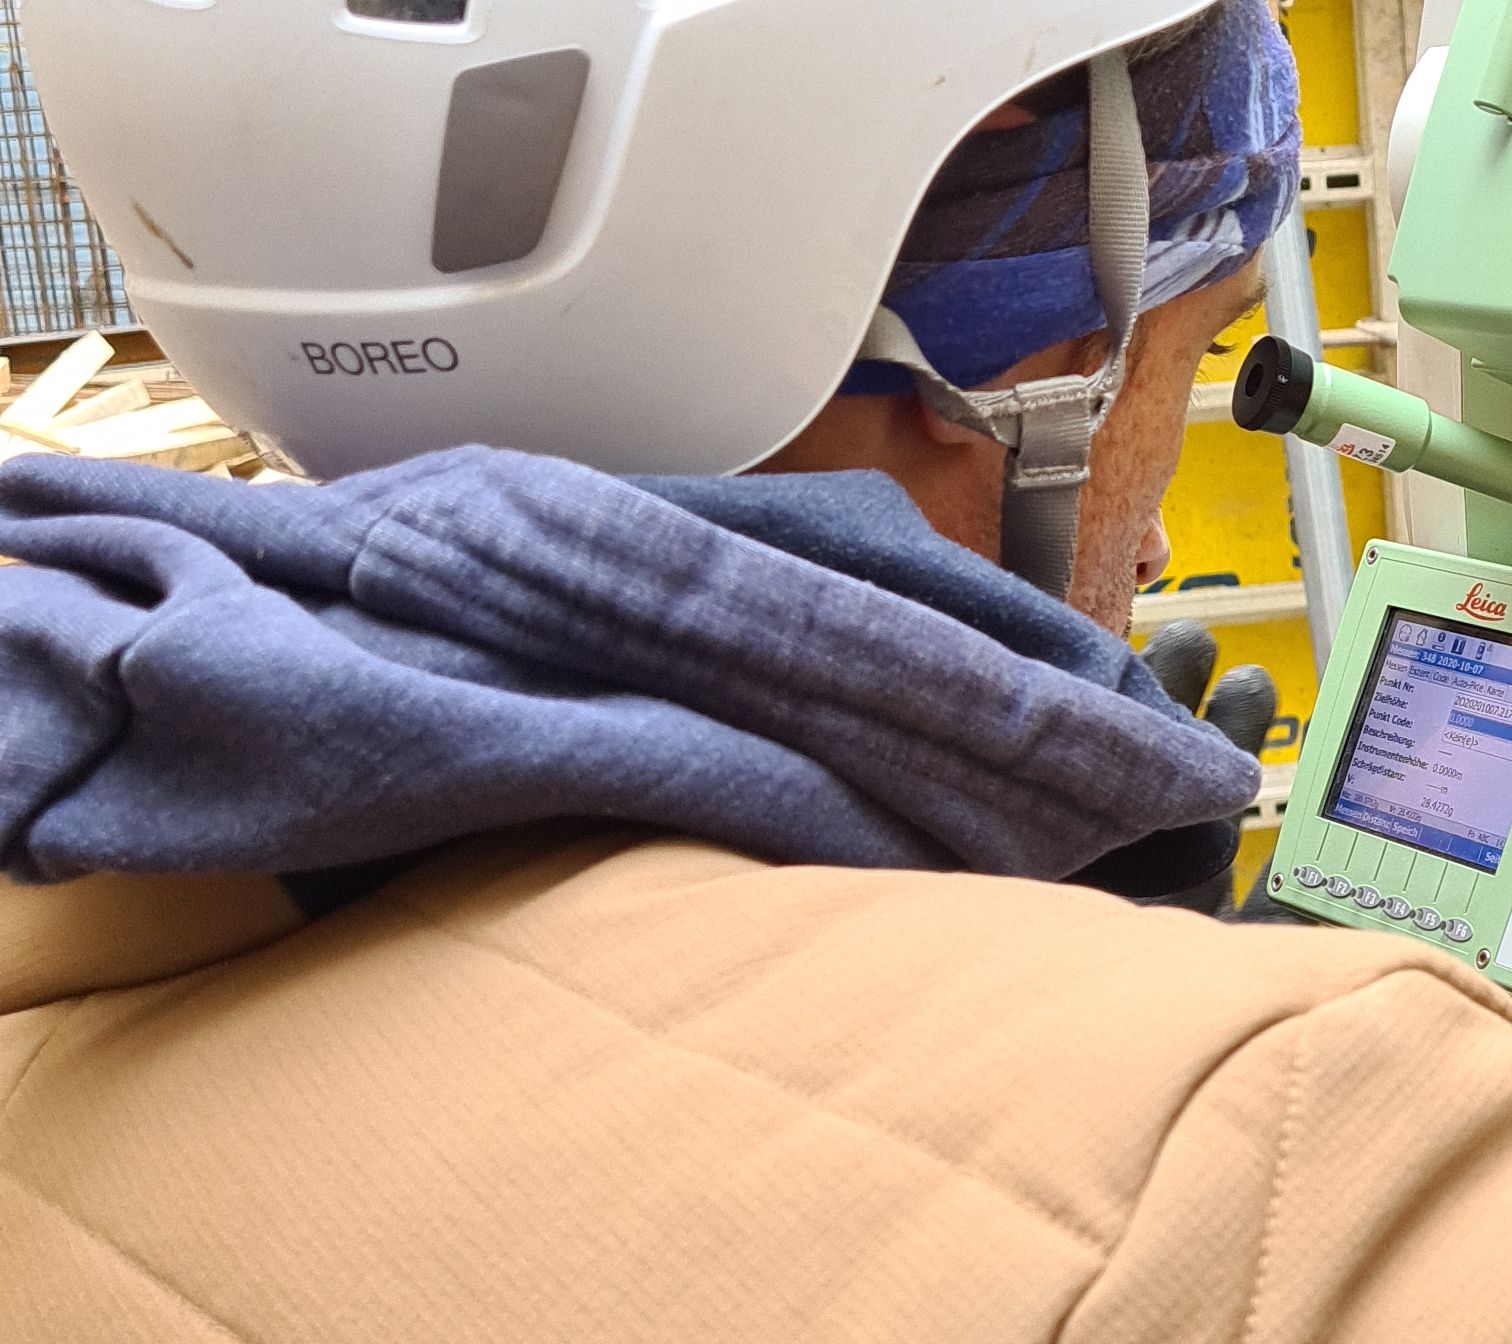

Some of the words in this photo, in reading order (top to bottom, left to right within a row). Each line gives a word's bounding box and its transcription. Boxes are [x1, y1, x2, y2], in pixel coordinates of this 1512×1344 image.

[301, 338, 459, 376] BOREO
[1456, 583, 1507, 621] Leica
[1308, 871, 1318, 882] F1
[1336, 881, 1348, 894] F2
[1365, 892, 1376, 904] F3
[1394, 902, 1405, 915] F4
[1424, 913, 1436, 926] F5
[1455, 925, 1467, 938] F6
